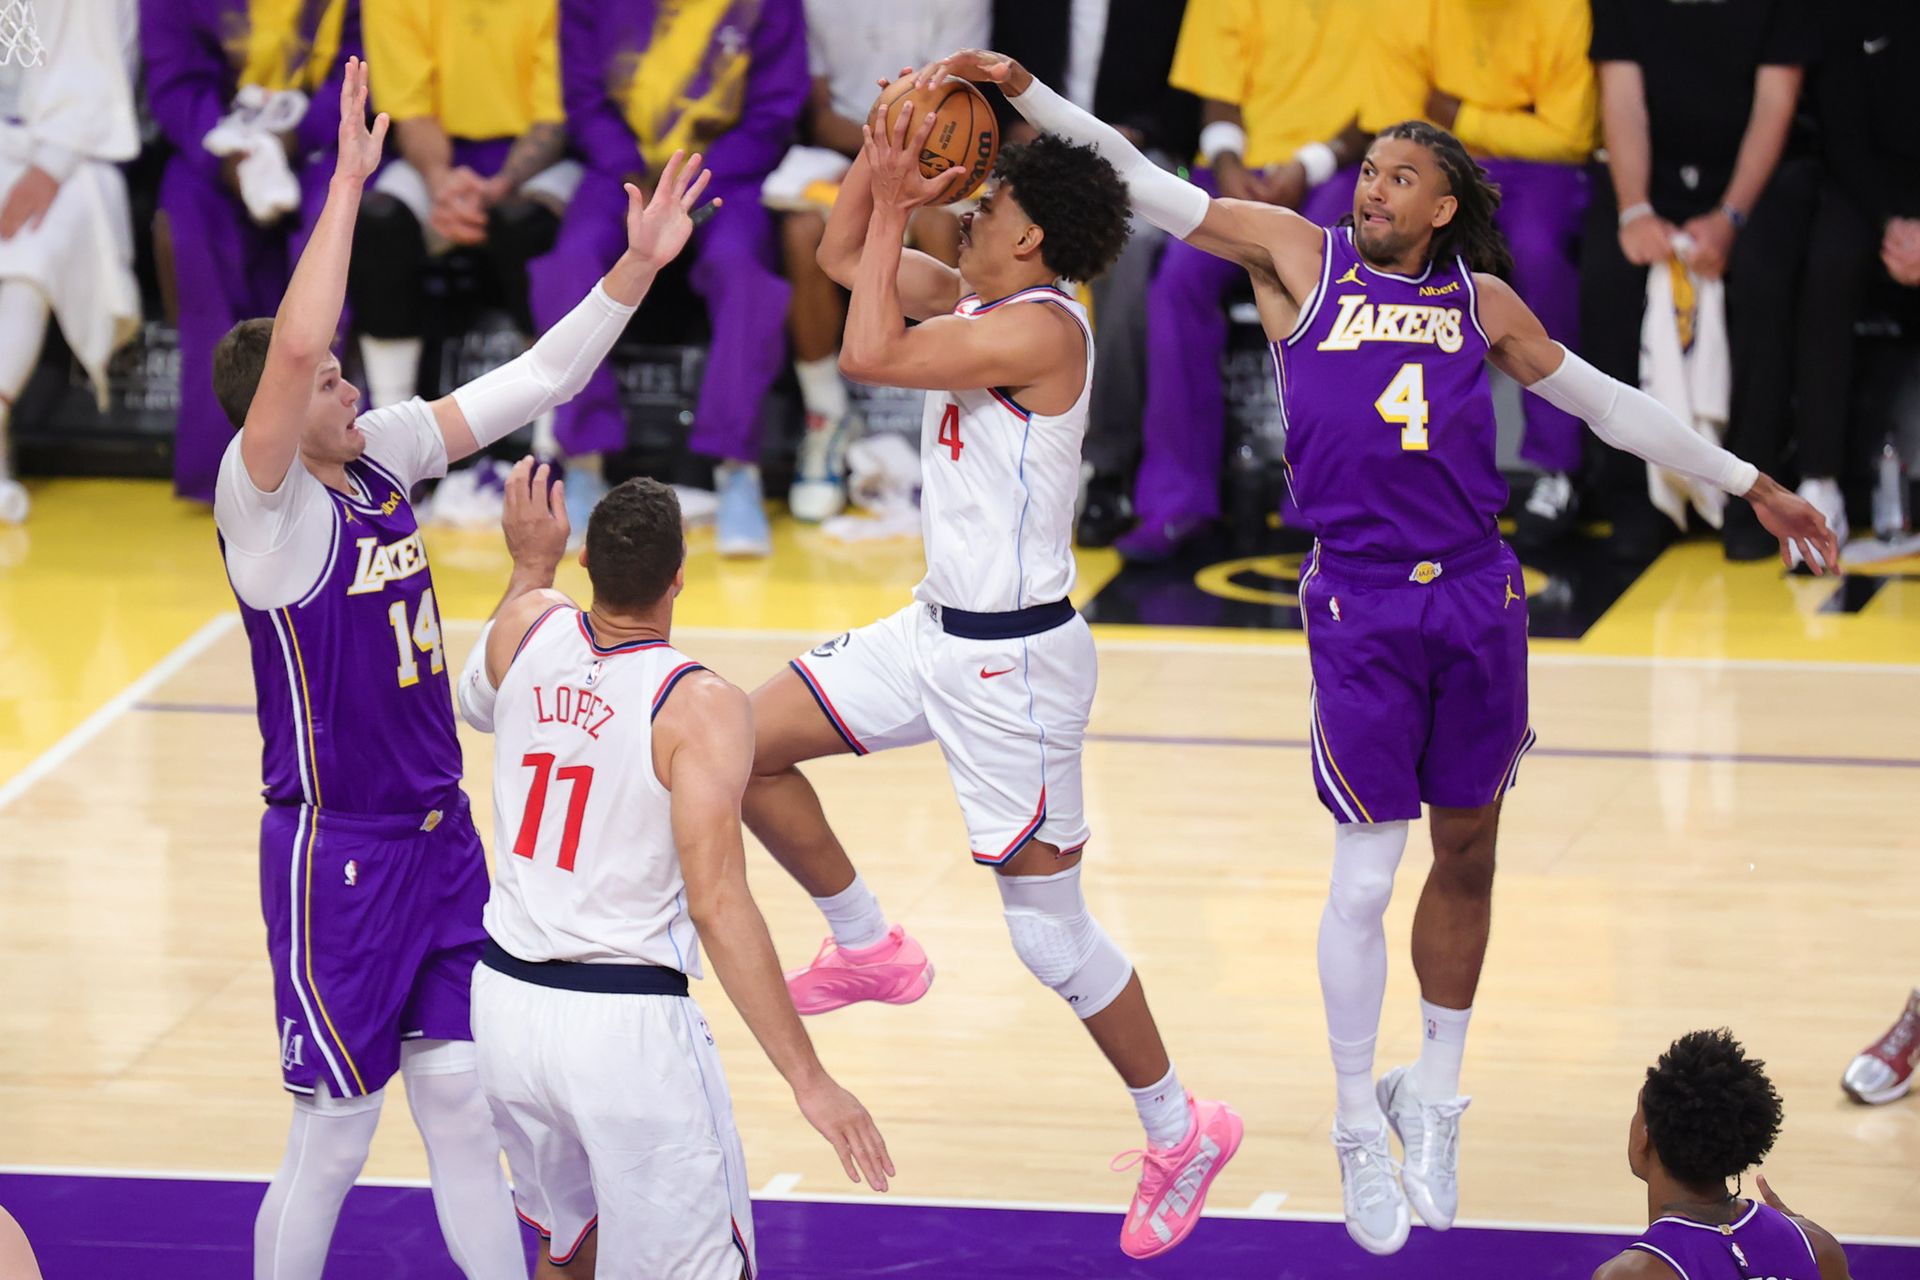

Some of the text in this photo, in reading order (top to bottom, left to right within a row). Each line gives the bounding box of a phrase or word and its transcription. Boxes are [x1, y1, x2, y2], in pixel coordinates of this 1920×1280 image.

[1419, 281, 1460, 297] Albert
[1316, 294, 1464, 353] LAKERS
[938, 403, 964, 462] 4
[1374, 363, 1430, 451] 4
[388, 587, 444, 688] 14
[533, 686, 615, 740] LOPEZ
[512, 752, 595, 873] 11
